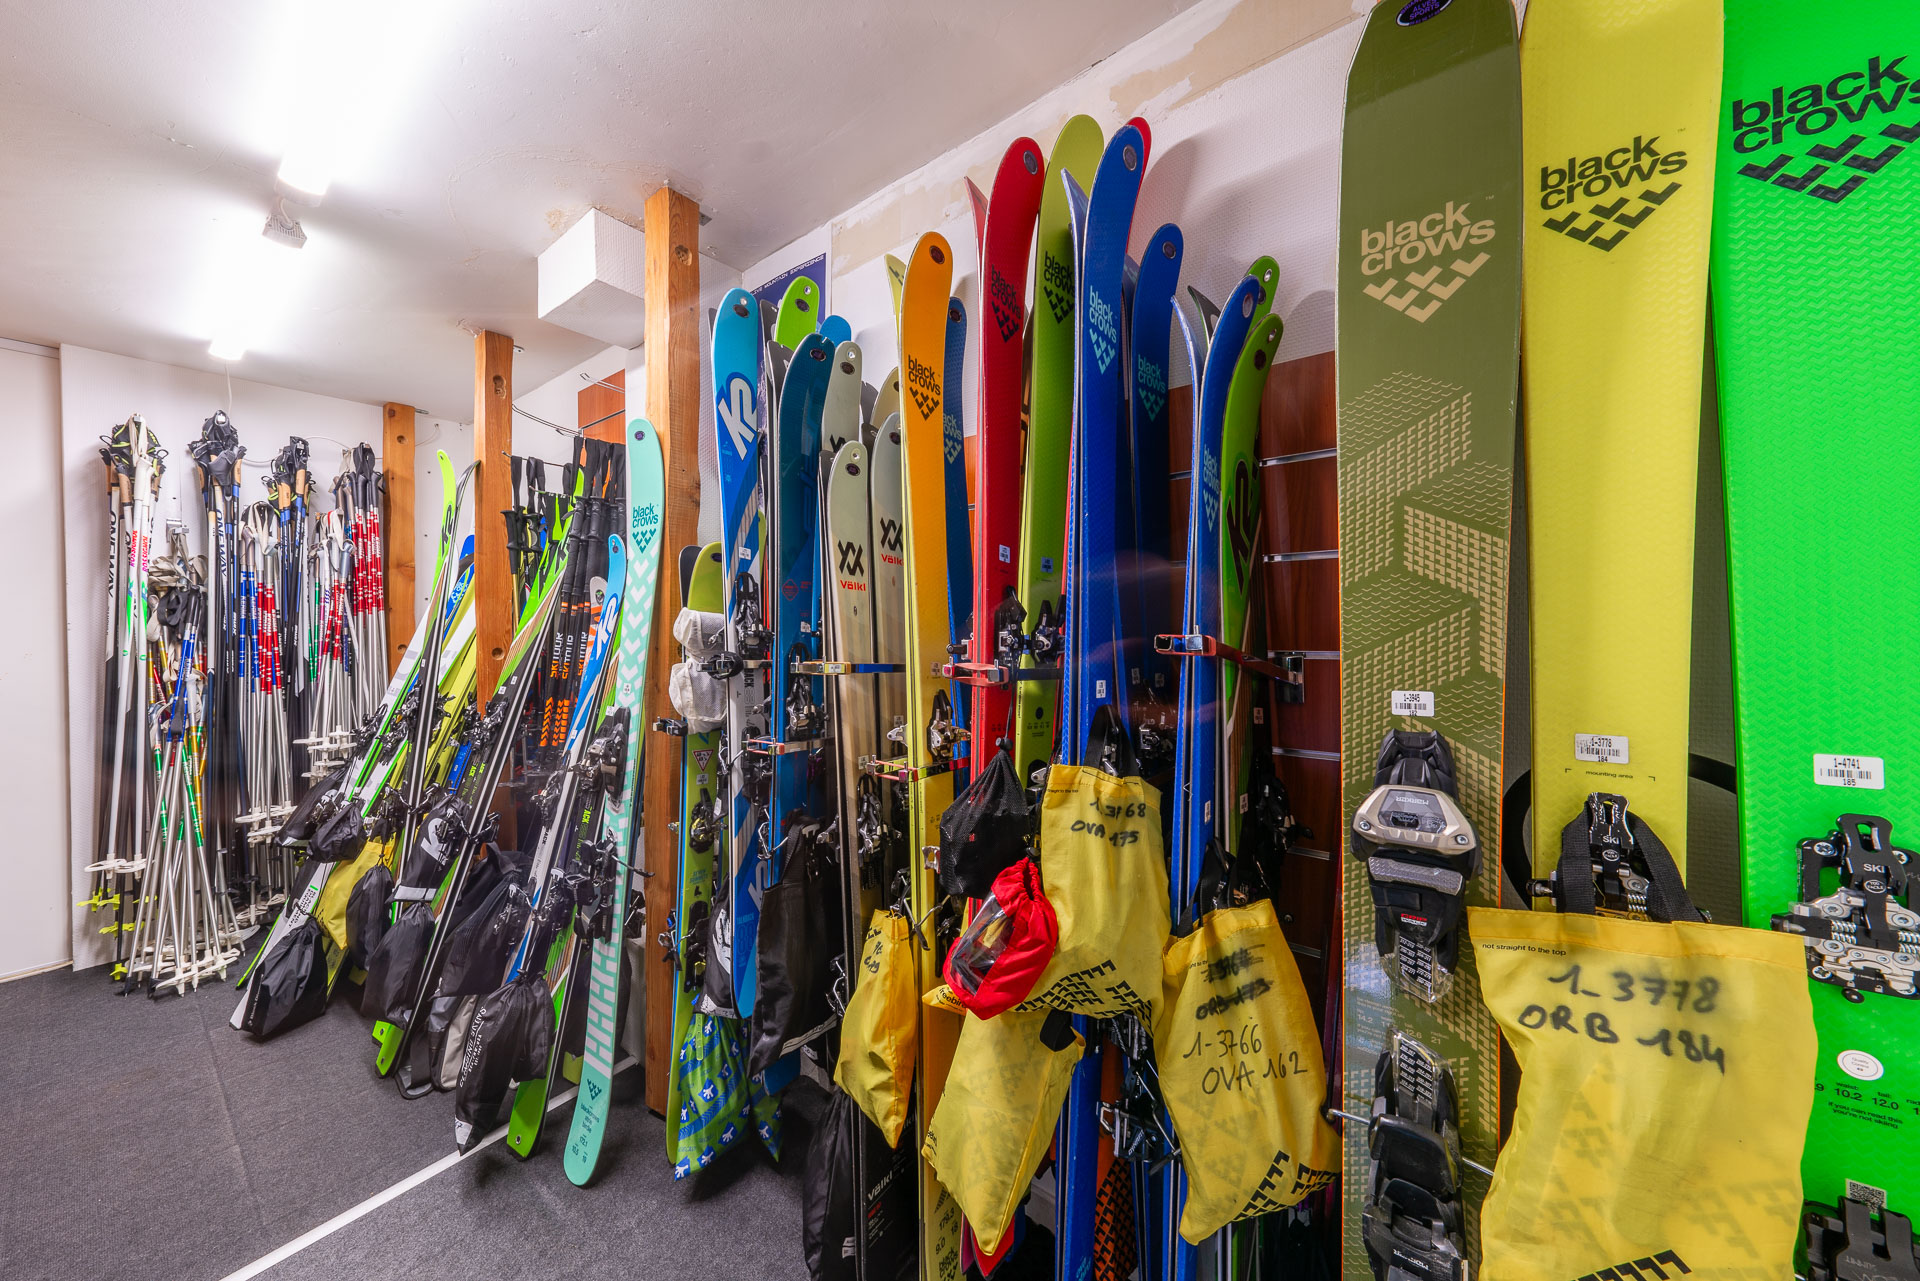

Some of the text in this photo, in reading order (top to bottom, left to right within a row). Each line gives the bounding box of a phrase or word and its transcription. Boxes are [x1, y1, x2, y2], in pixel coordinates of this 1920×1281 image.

[1732, 55, 1909, 131] black
[1732, 77, 1920, 154] crow
[1540, 135, 1661, 193] black
[1540, 151, 1688, 210] crows
[1361, 201, 1470, 257] black
[1361, 220, 1496, 277] crows
[1044, 251, 1072, 280] black
[991, 264, 1017, 299] black
[1044, 268, 1076, 296] crows
[991, 281, 1022, 320] crows
[1090, 286, 1114, 323] black
[1089, 306, 1117, 342] crows
[908, 355, 936, 383] black
[1138, 354, 1161, 382] black
[1138, 370, 1166, 394] crows
[908, 371, 940, 396] crows
[718, 377, 757, 461] K2
[942, 424, 962, 440] ows
[943, 413, 957, 430] ack
[1203, 444, 1218, 469] black
[1203, 463, 1220, 495] crows
[632, 504, 654, 519] black
[632, 513, 659, 528] crows
[216, 508, 227, 577] ONEWAY
[881, 553, 904, 566] Völk
[840, 579, 866, 592] Völkl
[550, 632, 564, 678] SKITOUR
[1586, 770, 1617, 778] mounting
[1834, 758, 1860, 770] 1-4741
[1843, 778, 1856, 786] 185
[1070, 820, 1106, 838] OVA
[1602, 836, 1619, 844] SKI
[1864, 864, 1885, 873] SKI
[1182, 1024, 1262, 1059] 1-3766
[1518, 1004, 1726, 1077] ORB 184
[1202, 1050, 1308, 1094] OVA 162
[1836, 1082, 1859, 1090] waist:
[1834, 1088, 1862, 1101] 10.2
[1872, 1097, 1899, 1110] 12.0
[1874, 1118, 1898, 1129] skiing
[1888, 1116, 1903, 1124] this
